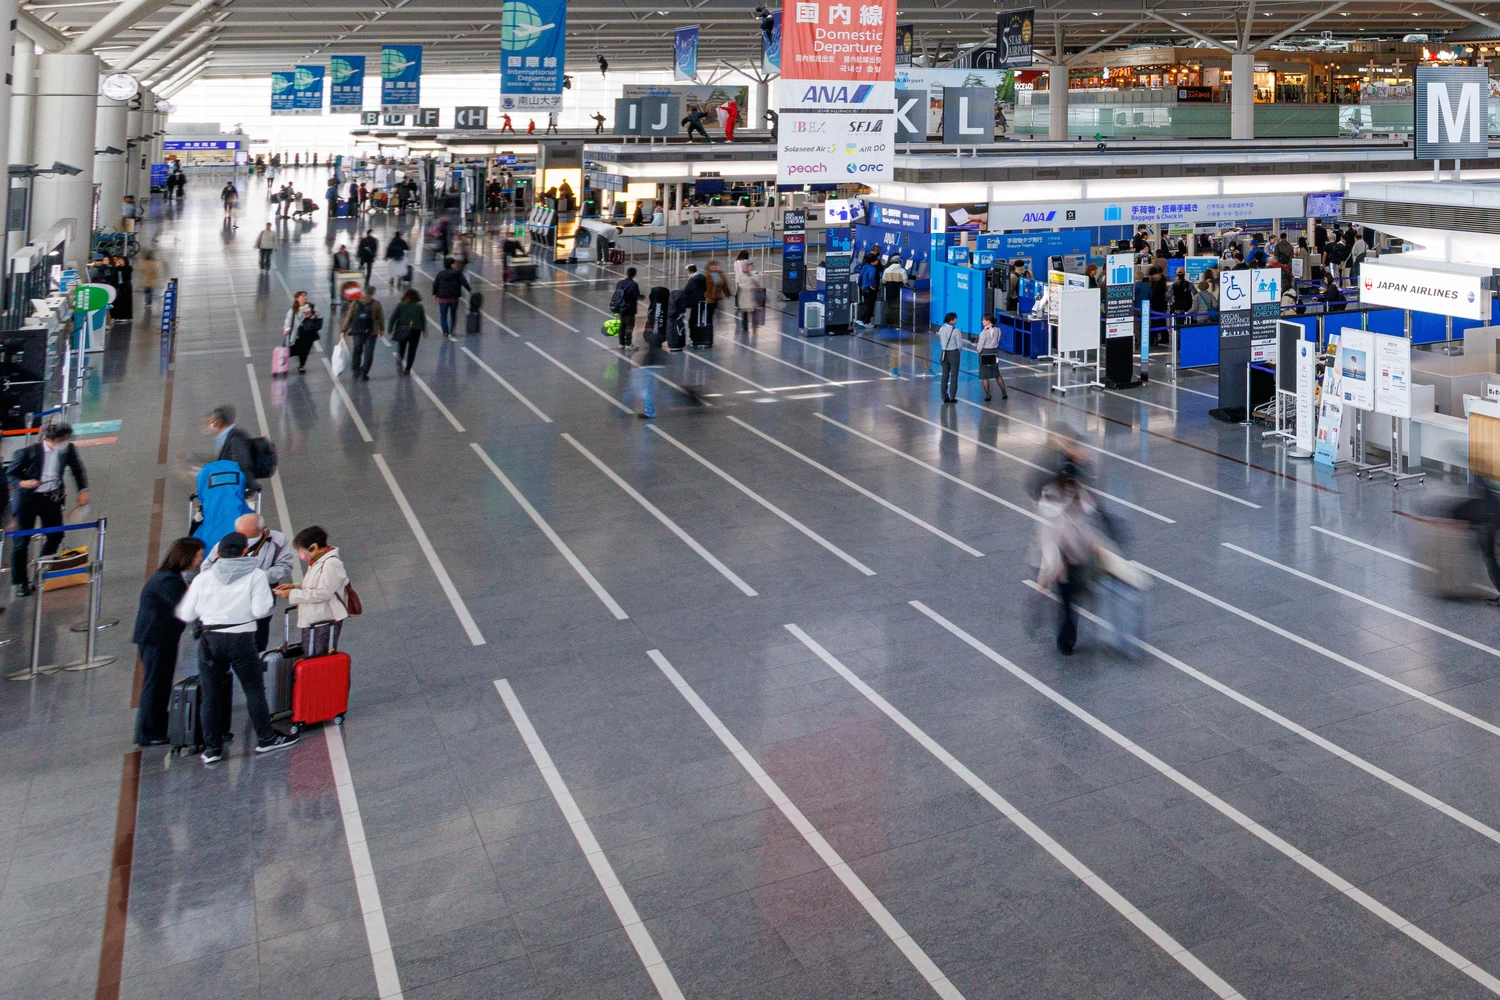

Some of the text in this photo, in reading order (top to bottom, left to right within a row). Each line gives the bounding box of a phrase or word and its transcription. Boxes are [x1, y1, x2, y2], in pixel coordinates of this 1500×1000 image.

[796, 1, 883, 26] 国内線
[815, 28, 883, 42] Domestic
[1008, 35, 1022, 45] STAR
[814, 40, 883, 55] Departure
[1000, 27, 1010, 64] 5
[1008, 44, 1032, 56] AIRPORT
[801, 85, 848, 103] ANA
[367, 112, 376, 124] B
[425, 110, 437, 125] F
[468, 109, 485, 126] H
[651, 103, 668, 130] J
[894, 98, 919, 133] K
[959, 96, 984, 135] L
[1426, 82, 1481, 144] M
[791, 121, 826, 133] IBEX
[784, 145, 815, 153] Solaseed
[859, 145, 872, 153] AIR
[873, 144, 886, 152] DO
[787, 163, 884, 176] peach ORC
[1131, 203, 1199, 215] 手荷物・搭乗手続き
[1022, 212, 1045, 223] ANA
[1131, 214, 1155, 222] Baggage
[828, 228, 835, 237] 3
[1108, 255, 1115, 265] 4
[1222, 272, 1229, 284] 5
[1254, 270, 1261, 282] 7
[1107, 285, 1131, 293] BAGGAGE
[1377, 281, 1459, 300] JAPAN AIRLINES
[1253, 303, 1280, 311] TICKETING
[1220, 317, 1251, 325] ASSISTANCE
